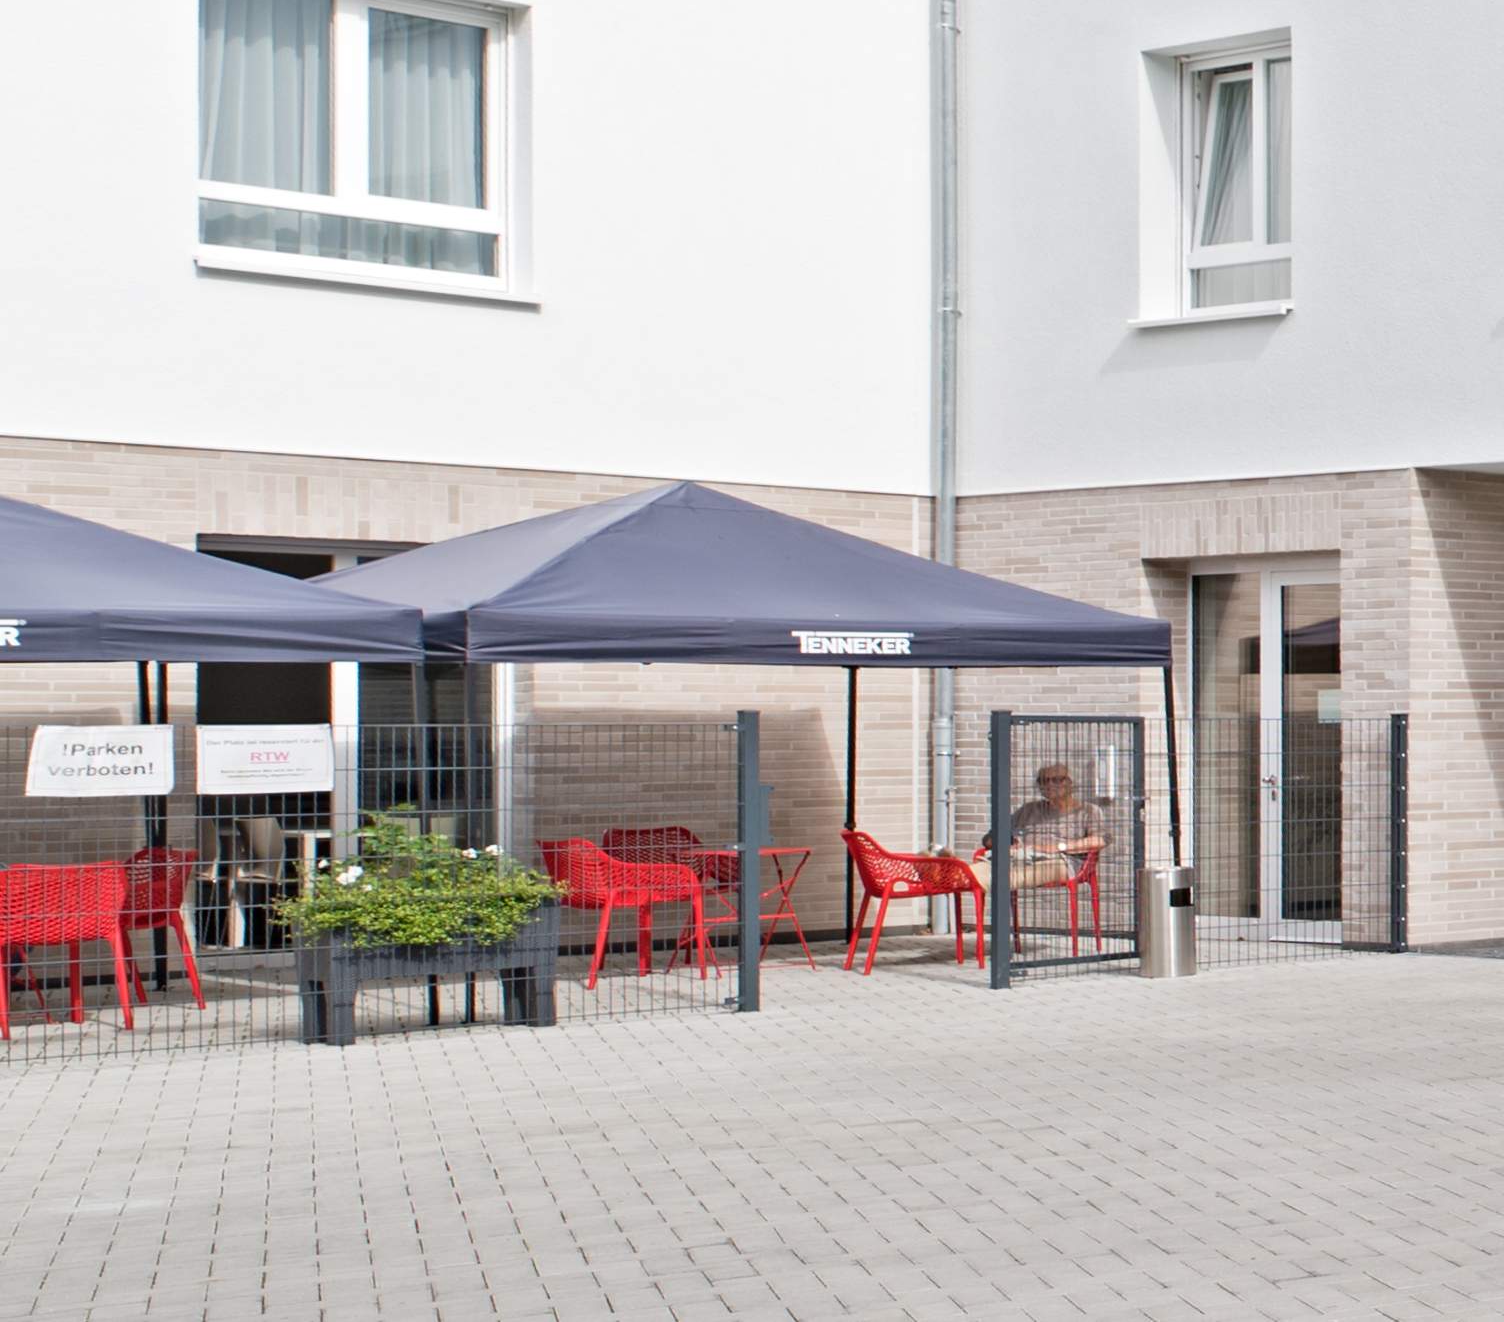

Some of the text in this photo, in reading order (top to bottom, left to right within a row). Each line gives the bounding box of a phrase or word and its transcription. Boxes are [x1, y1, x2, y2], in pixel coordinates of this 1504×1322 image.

[791, 631, 914, 654] TENNEKER
[63, 743, 143, 757] !Parken
[250, 751, 290, 762] RTW
[47, 762, 154, 777] verboten!
